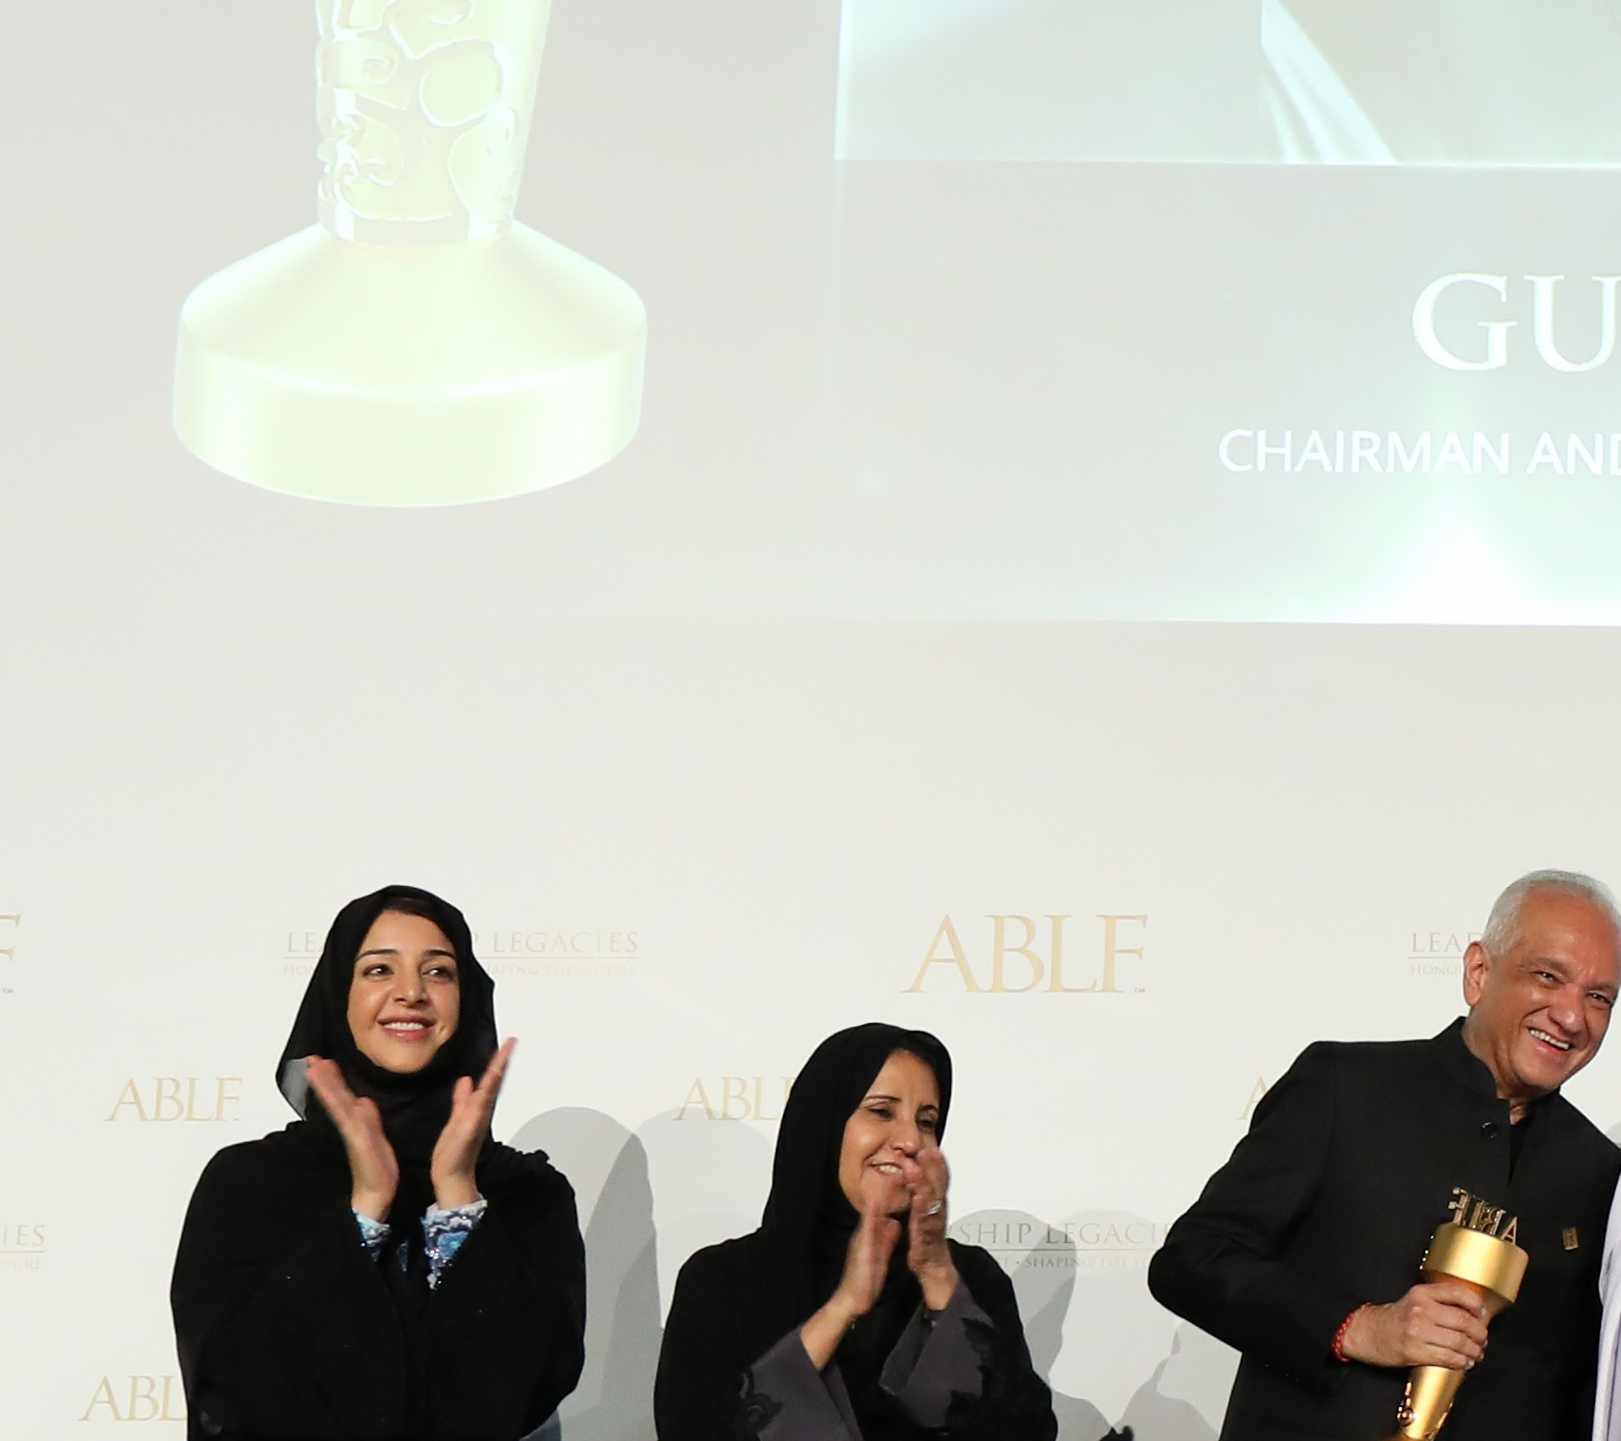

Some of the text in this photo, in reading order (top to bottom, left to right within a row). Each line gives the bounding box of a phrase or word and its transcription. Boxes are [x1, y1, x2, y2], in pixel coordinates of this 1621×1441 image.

[1217, 428, 1510, 474] CHAIRMAN
[493, 931, 638, 956] LEGACIES
[902, 915, 1147, 993] ABLF
[106, 1077, 243, 1122] ABLF
[78, 1375, 187, 1422] ABL
